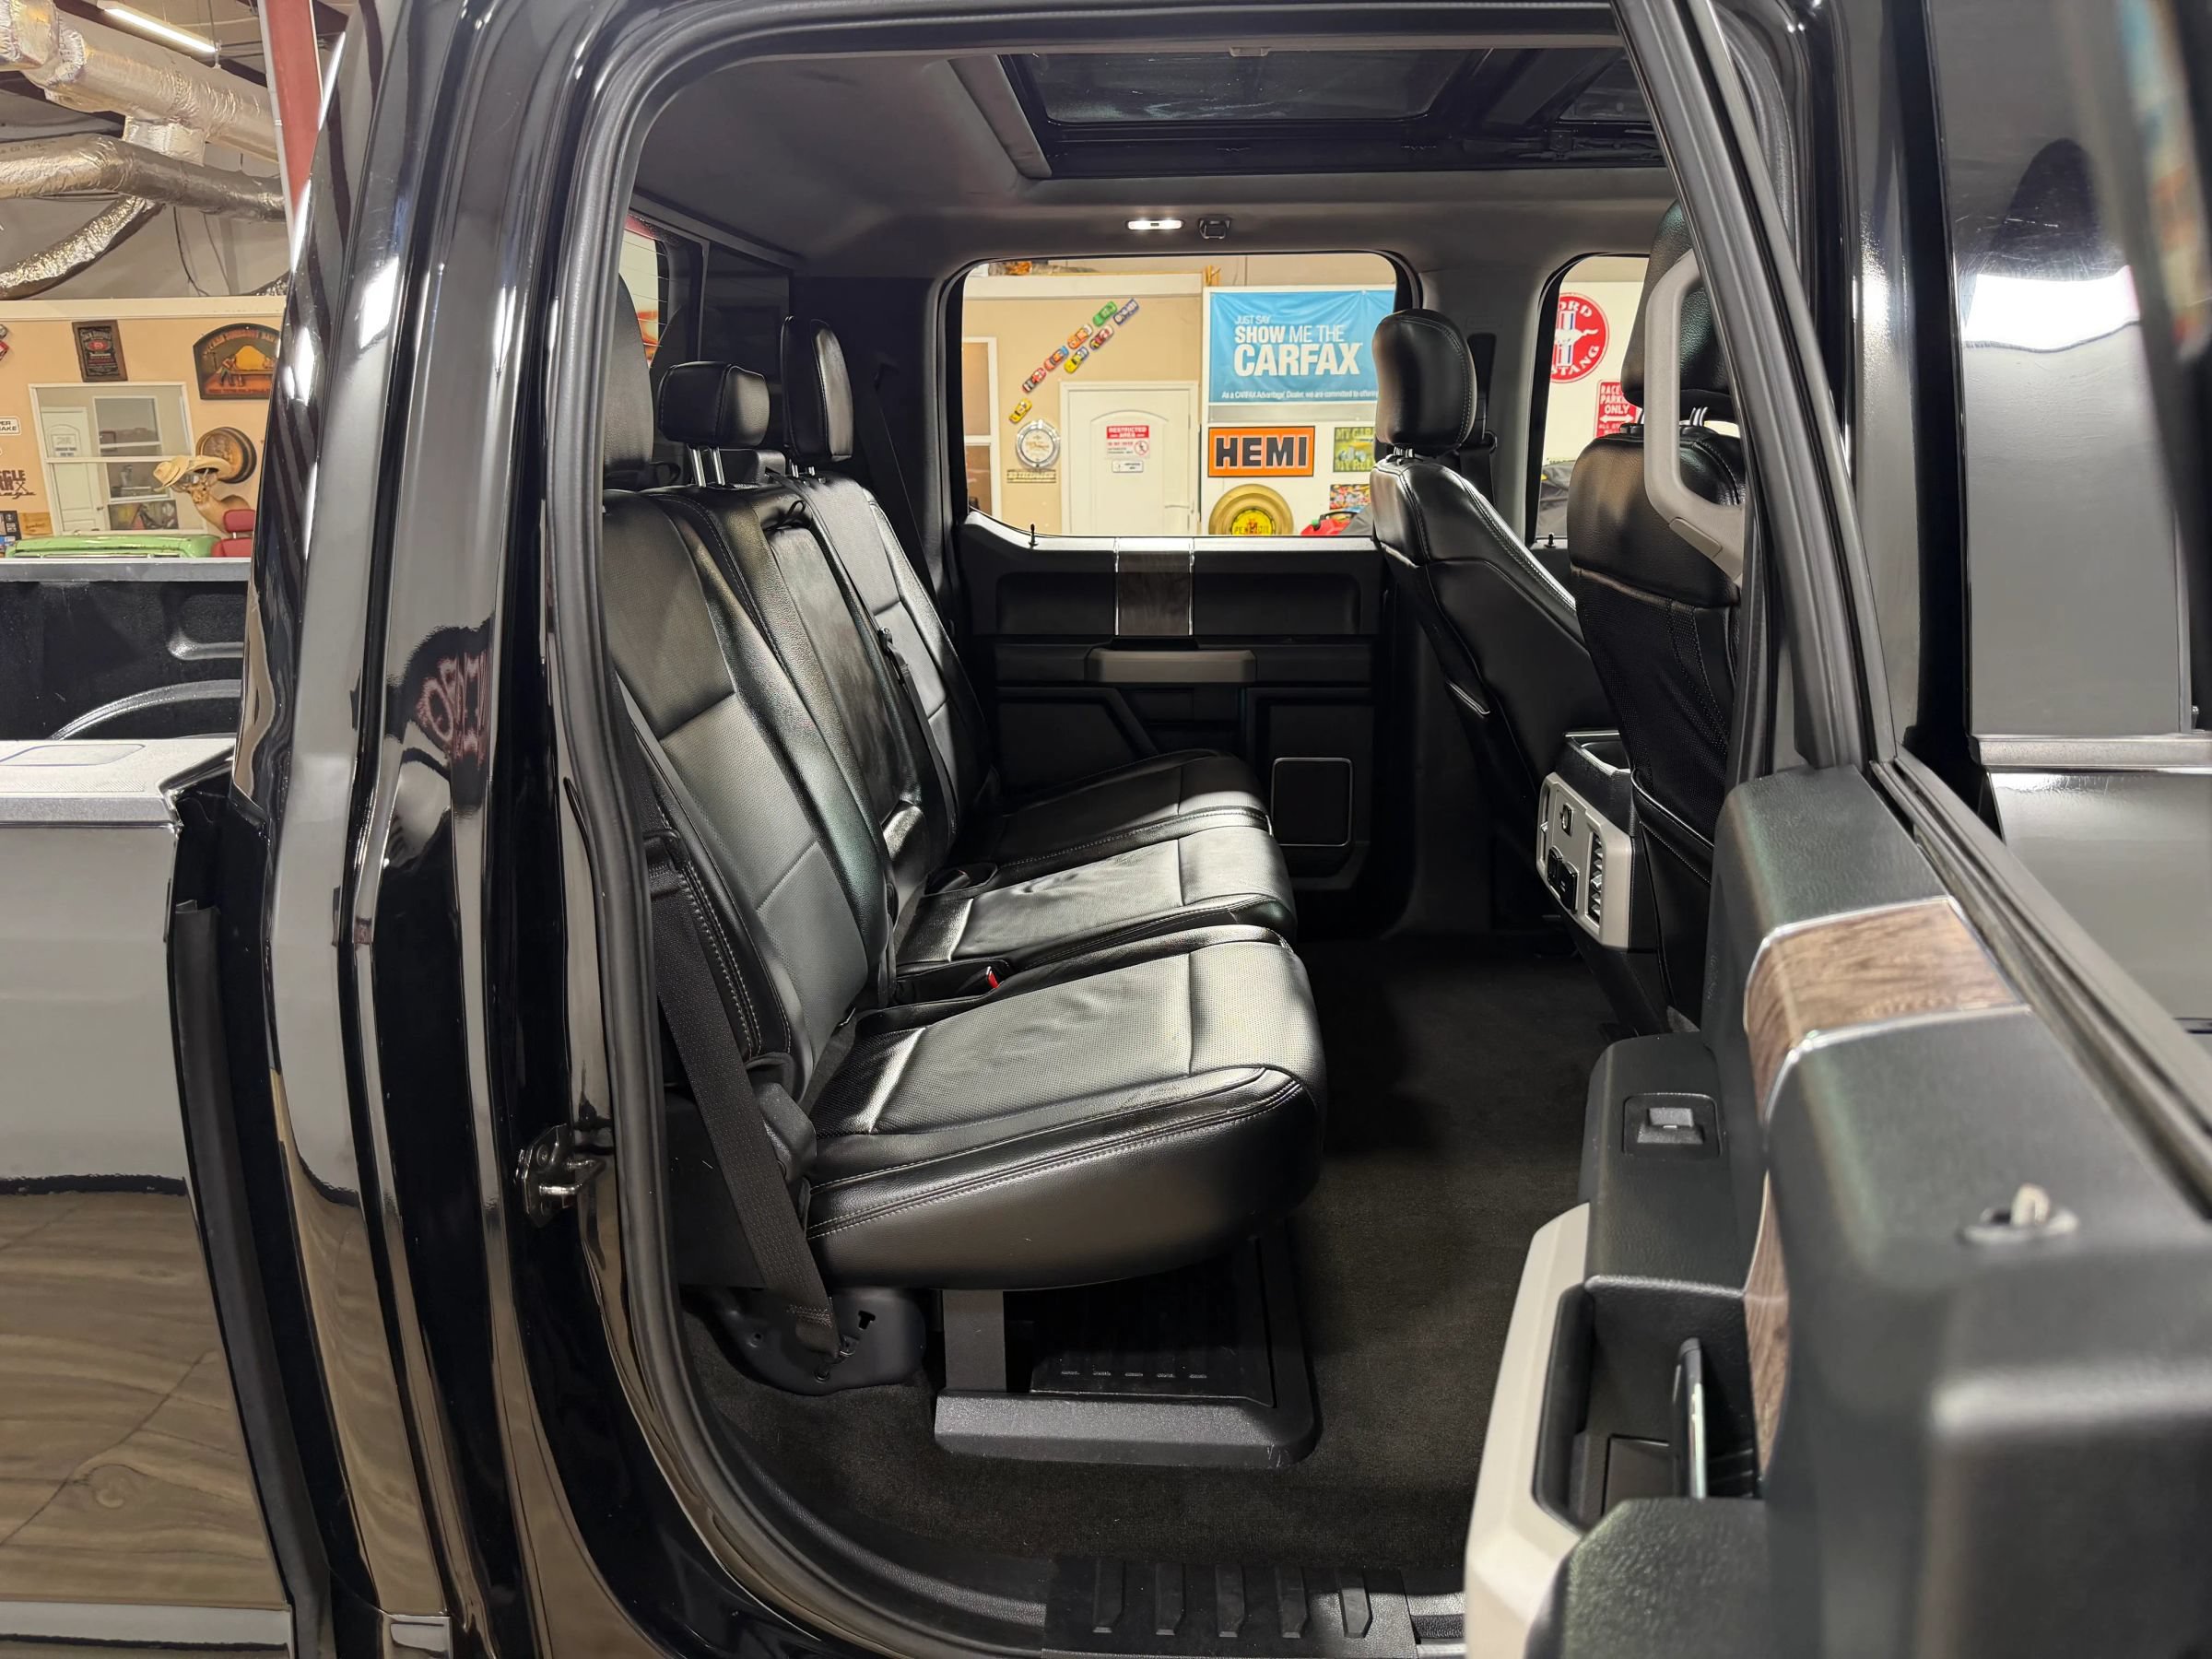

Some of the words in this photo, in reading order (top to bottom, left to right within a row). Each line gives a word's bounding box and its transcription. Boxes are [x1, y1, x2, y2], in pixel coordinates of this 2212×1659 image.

[1234, 315, 1253, 324] JUST
[1255, 314, 1271, 324] SAY
[1234, 325, 1286, 344] SHOW
[1288, 325, 1312, 343] ME
[1317, 324, 1346, 342] THE
[1234, 343, 1361, 377] CARFAX
[1605, 405, 1630, 415] ONLY
[1215, 436, 1308, 469] HEMI
